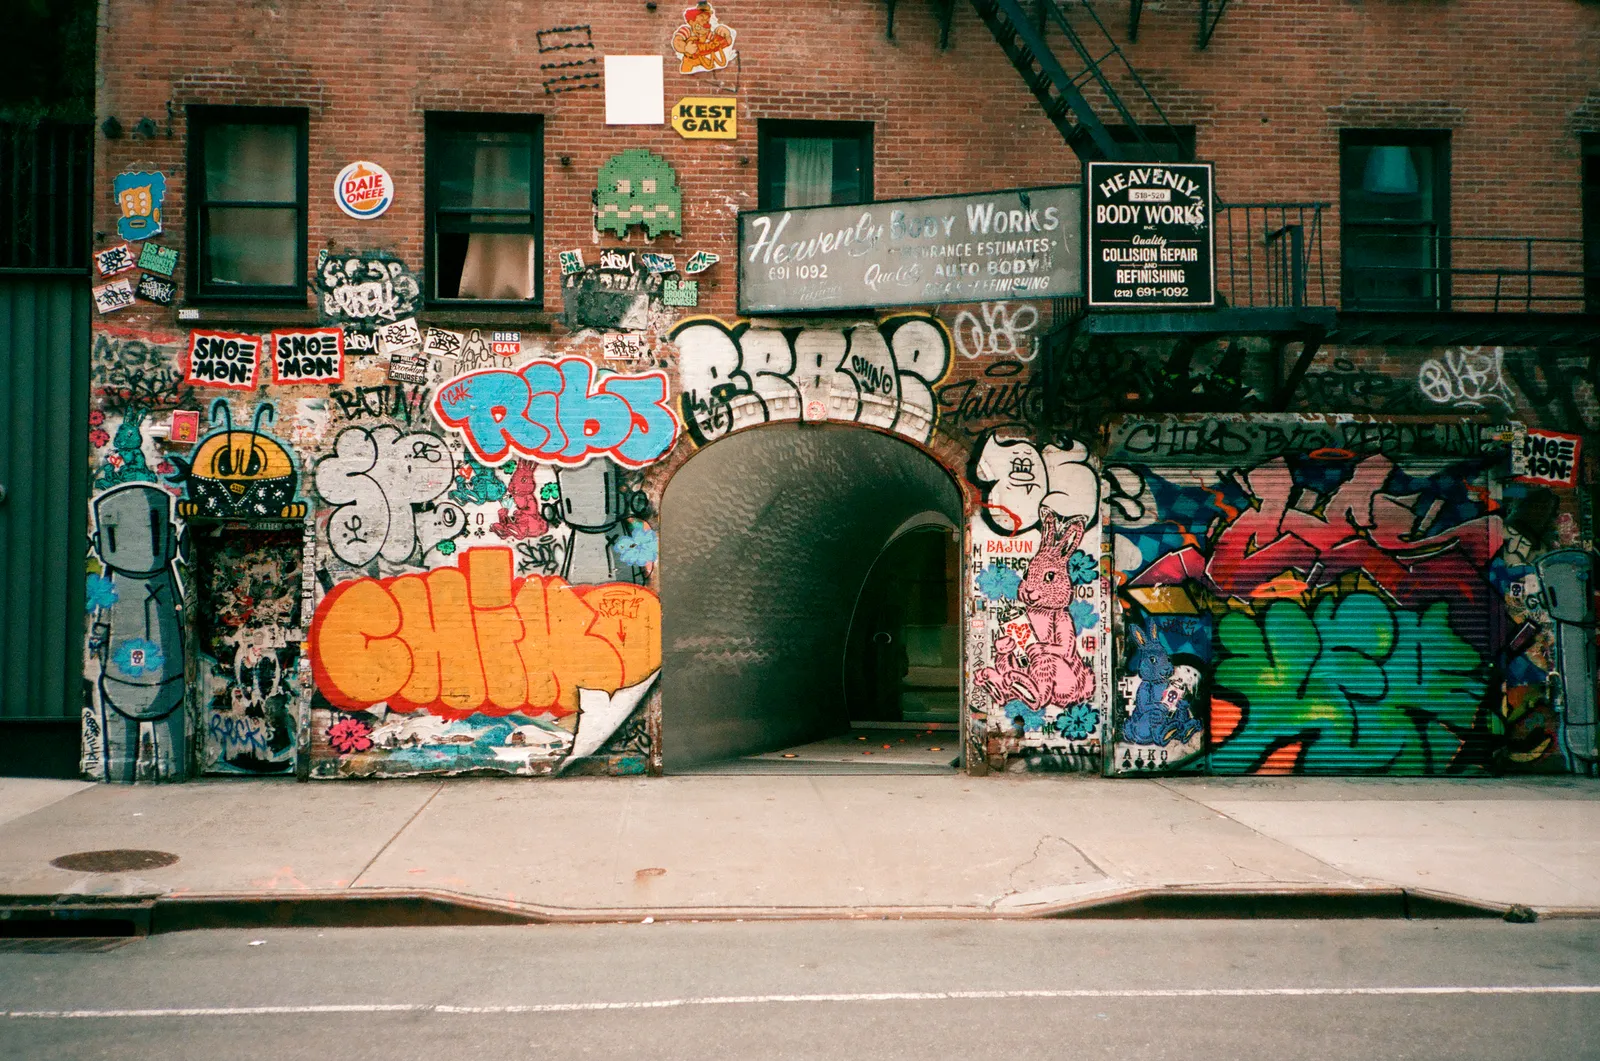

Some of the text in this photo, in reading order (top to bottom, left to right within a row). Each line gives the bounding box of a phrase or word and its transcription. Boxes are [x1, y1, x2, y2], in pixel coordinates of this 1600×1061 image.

[679, 105, 735, 118] KEST
[682, 119, 728, 132] GAK
[345, 174, 383, 194] DAIE
[1099, 168, 1200, 198] HEAVENLY
[346, 188, 385, 203] ONEEE
[1097, 205, 1204, 224] BODY WORKS
[747, 211, 884, 264] Heavenly
[1132, 234, 1168, 249] Quality
[899, 241, 972, 259] URANCE
[1103, 248, 1198, 262] COLLISION REPAIR
[768, 264, 828, 280] 691 1092
[934, 262, 980, 278] AUTO
[987, 258, 1040, 276] BODY
[1116, 269, 1185, 284] REFINISHING
[972, 276, 1050, 293] EFINISHING
[1114, 287, 1189, 298] (212) 691-1092
[494, 332, 519, 341] RIBS
[495, 344, 517, 353] GAK
[852, 354, 893, 395] CHINO
[986, 540, 1033, 554] BAJUN
[1122, 748, 1169, 761] AIKO
